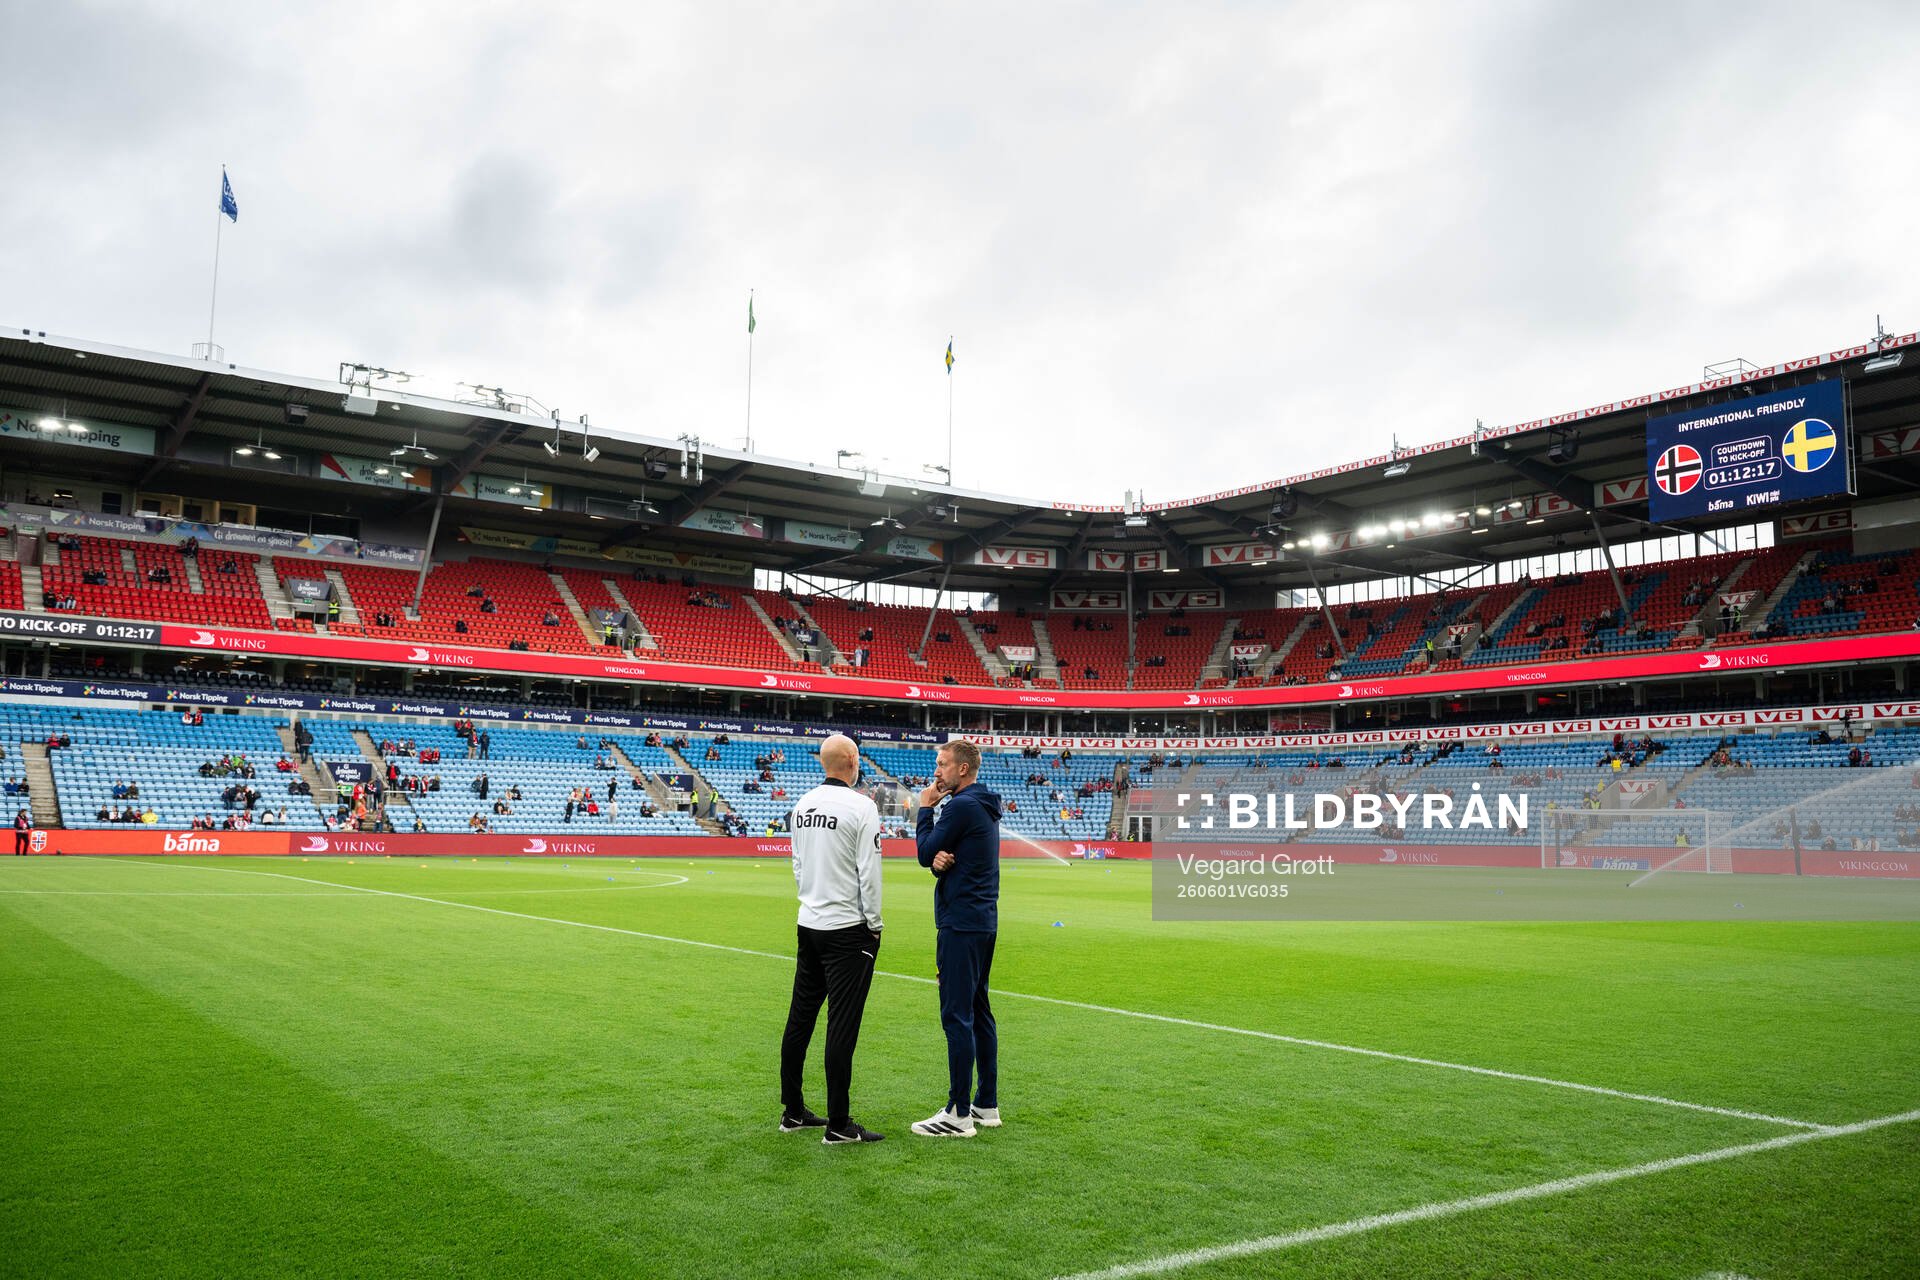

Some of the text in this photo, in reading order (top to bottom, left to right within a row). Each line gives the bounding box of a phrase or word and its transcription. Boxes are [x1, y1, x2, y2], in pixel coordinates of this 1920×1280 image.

[1881, 334, 1914, 348] VG
[1831, 345, 1865, 361] VG
[1786, 356, 1819, 372] VG
[1742, 367, 1774, 381] VG
[1701, 377, 1731, 391] VG
[1661, 386, 1690, 400] VG
[1622, 396, 1650, 408] VG
[1586, 404, 1612, 417] VG
[1678, 397, 1806, 433] INTERNATIONAL FRIENDLY
[1550, 413, 1576, 425] VG
[1516, 420, 1541, 432] VG
[67, 424, 121, 447] pping
[1484, 428, 1507, 440] VG
[1452, 435, 1475, 446] VG
[1422, 443, 1444, 453] VG
[1717, 439, 1766, 456] COUNTDOWN
[1365, 457, 1385, 466] VG
[1718, 449, 1765, 464] TO KICK-OFF
[1339, 463, 1358, 472] VG
[1313, 469, 1331, 478] VG
[1708, 462, 1775, 485] 01:12:17
[1262, 480, 1280, 489] VG
[1287, 475, 1305, 484] VG
[1239, 486, 1256, 494] VG
[1193, 497, 1209, 505] VG
[1746, 491, 1769, 505] KIWI
[1168, 501, 1187, 509] VG
[89, 518, 146, 532] Norsk Tipping
[1787, 512, 1848, 532] VG
[984, 549, 1046, 565] VG
[1213, 543, 1273, 562] VG
[1099, 551, 1156, 569] VG
[1056, 592, 1120, 608] VG
[1153, 591, 1217, 607] VG
[20, 618, 87, 635] KICK-OFF
[96, 624, 155, 640] 01:12:17
[220, 637, 266, 650] VIKING
[433, 653, 474, 665] VIKING
[1725, 654, 1769, 667] VIKING
[604, 666, 645, 675] VIKING.COM
[1507, 672, 1547, 681] VIKING.COM
[9, 682, 64, 694] Norsk Tipping
[780, 679, 811, 689] VIKING
[97, 687, 149, 699] Norsk Tipping
[923, 690, 950, 699] VIKING
[1355, 686, 1384, 695] VIKING
[179, 692, 228, 703] Norsk Tipping
[257, 696, 304, 707] Norsk Tipping
[1019, 695, 1055, 703] VIKING.COM
[1203, 695, 1234, 704] VIKING
[331, 700, 376, 711] Norsk Tipping
[402, 704, 444, 715] Norsk Tipping
[1876, 705, 1920, 716] VG
[470, 708, 509, 718] Norsk Tipping
[533, 712, 571, 722] Norsk Tipping
[1756, 711, 1799, 723] VG
[1815, 708, 1859, 719] VG
[610, 717, 630, 725] Tipping
[669, 720, 687, 728] Tipping
[1650, 717, 1690, 728] VG
[1702, 714, 1744, 725] VG
[724, 723, 741, 731] Tipping
[777, 726, 794, 734] Tipping
[1510, 724, 1544, 735] VG
[1554, 722, 1590, 733] VG
[1601, 720, 1638, 731] VG
[876, 731, 891, 739] Tipping
[1390, 731, 1419, 741] VG
[1428, 729, 1458, 739] VG
[1468, 727, 1500, 737] VG
[923, 734, 937, 742] Tipping
[1042, 738, 1072, 746] VG
[1083, 739, 1113, 747] VG
[1206, 739, 1236, 747] VG
[1245, 738, 1274, 747] VG
[1282, 737, 1310, 746] VG
[1320, 735, 1345, 744] VG
[1354, 733, 1382, 743] VG
[334, 840, 385, 852] VIKING
[551, 843, 595, 854] VIKING
[757, 844, 793, 852] VIKING.CO
[1401, 852, 1438, 863] VIKING
[1838, 860, 1908, 872] VIKING.COM
